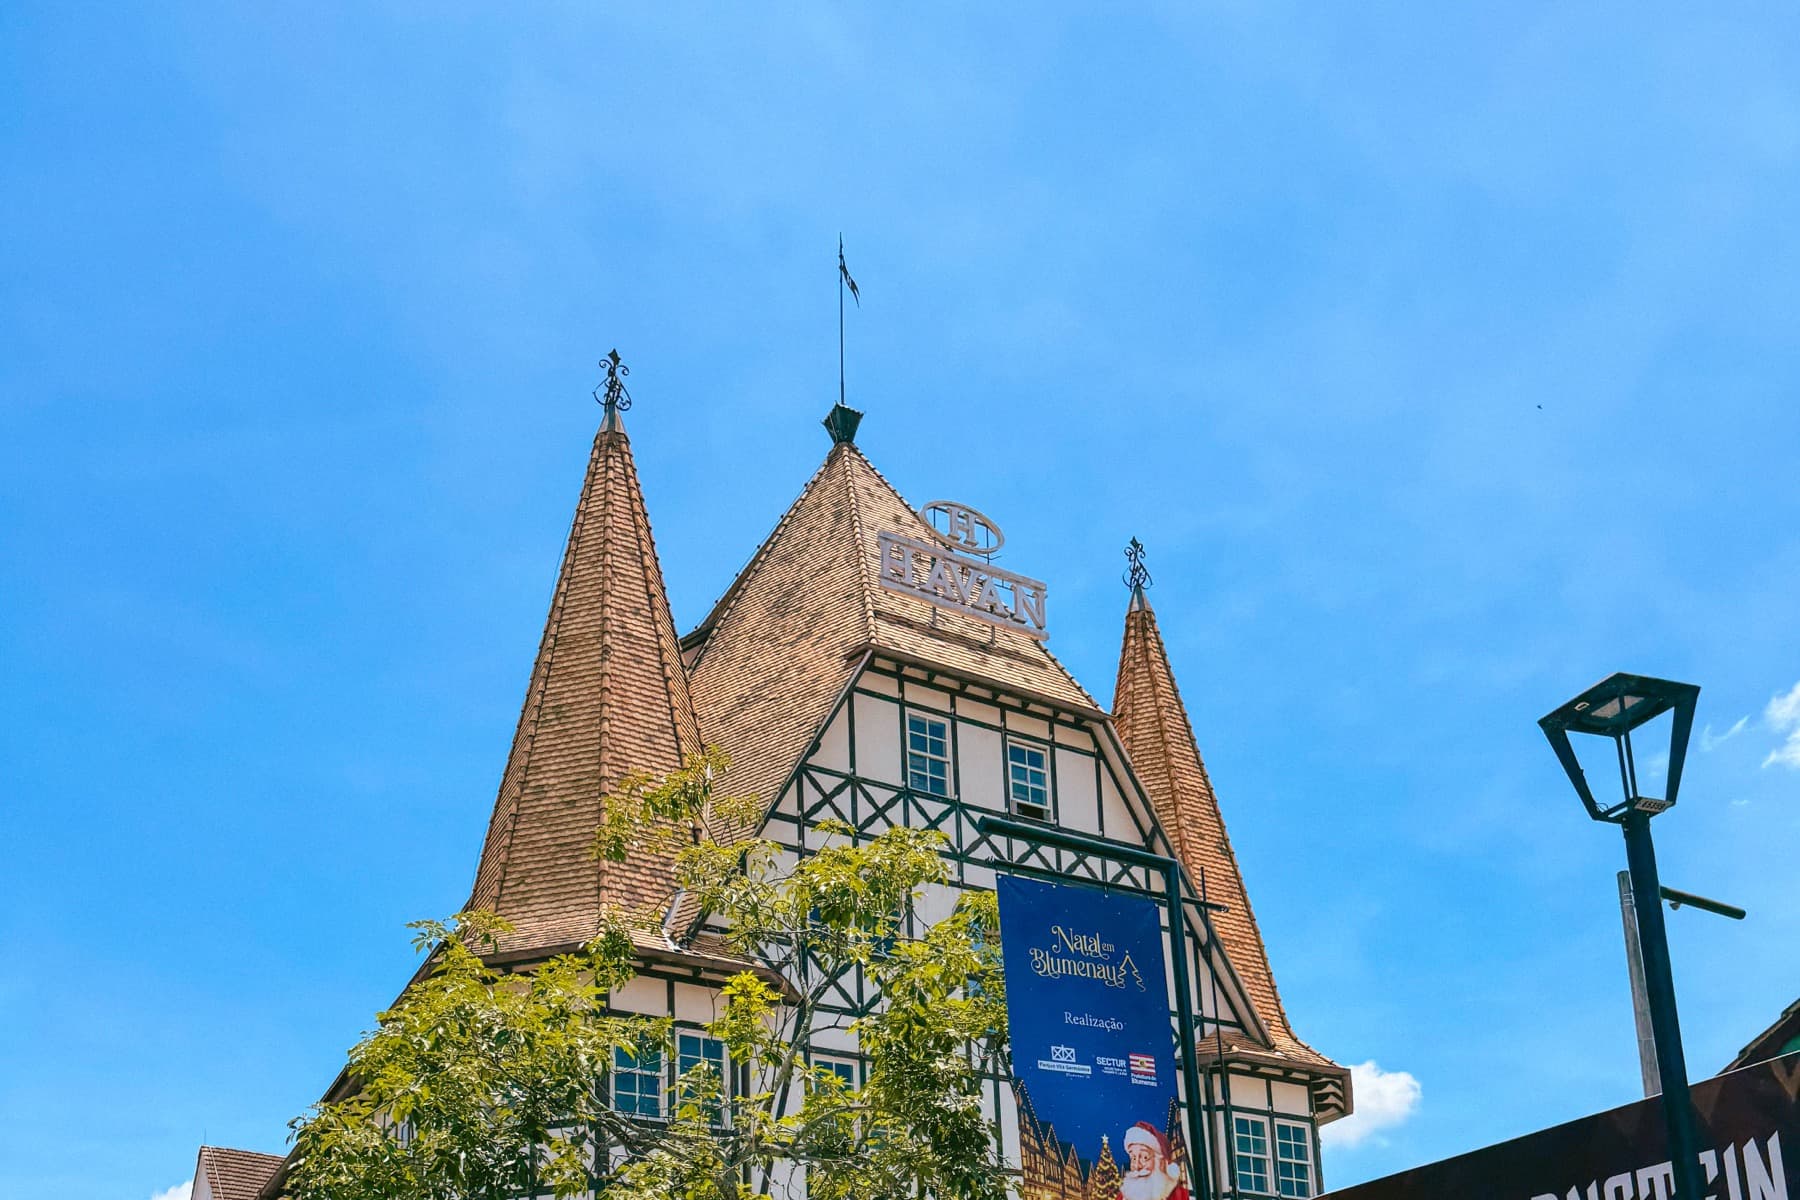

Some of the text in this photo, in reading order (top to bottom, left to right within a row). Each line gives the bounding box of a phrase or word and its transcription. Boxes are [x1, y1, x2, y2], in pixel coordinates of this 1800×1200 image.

[947, 507, 979, 547] H
[879, 538, 1048, 631] HAVAN
[1051, 925, 1115, 960] Natal em
[1064, 1011, 1124, 1032] Realização
[1096, 1056, 1126, 1068] SECTUR
